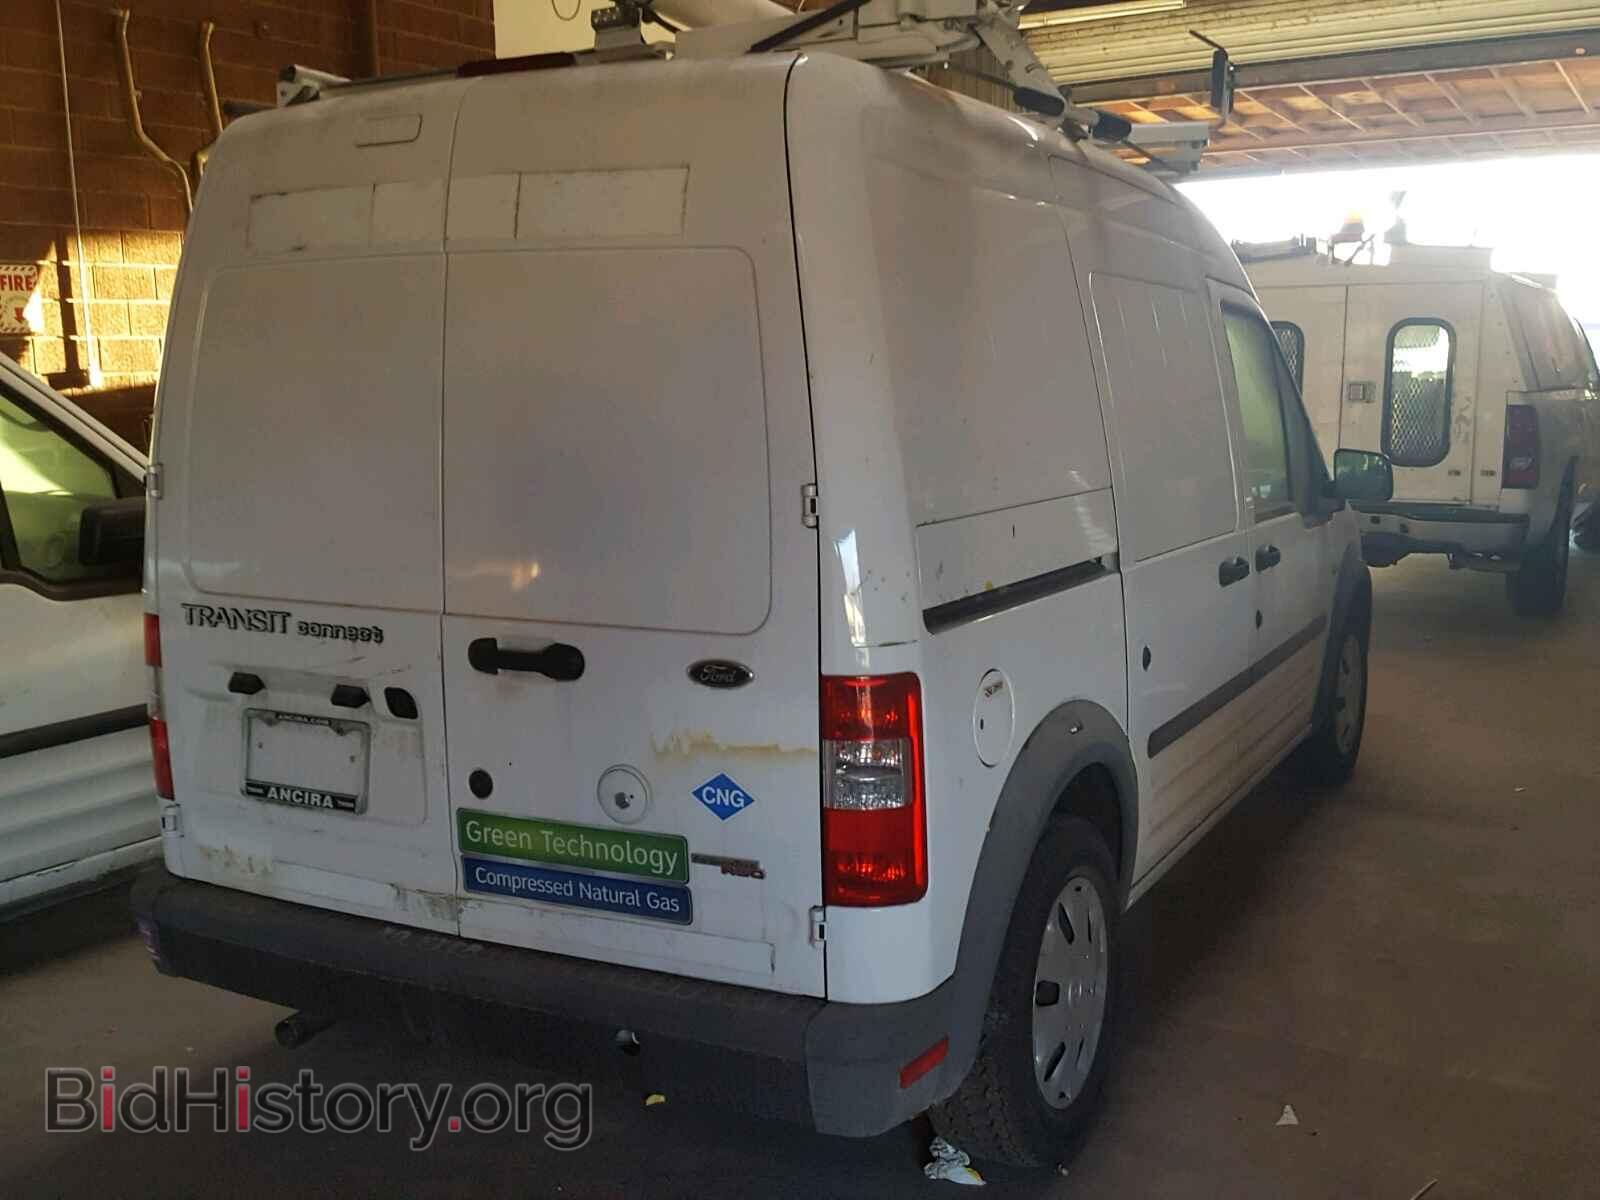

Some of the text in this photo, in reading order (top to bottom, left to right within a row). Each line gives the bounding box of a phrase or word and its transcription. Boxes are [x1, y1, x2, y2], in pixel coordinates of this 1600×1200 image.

[0, 274, 34, 292] FIRE
[181, 603, 384, 643] TRANSIT connect
[700, 664, 736, 682] Ford
[266, 786, 334, 809] ANCIRA
[701, 786, 745, 808] CNG
[465, 820, 532, 850] Green
[540, 829, 678, 876] Technology
[475, 866, 680, 913] Compressed Natural Gas
